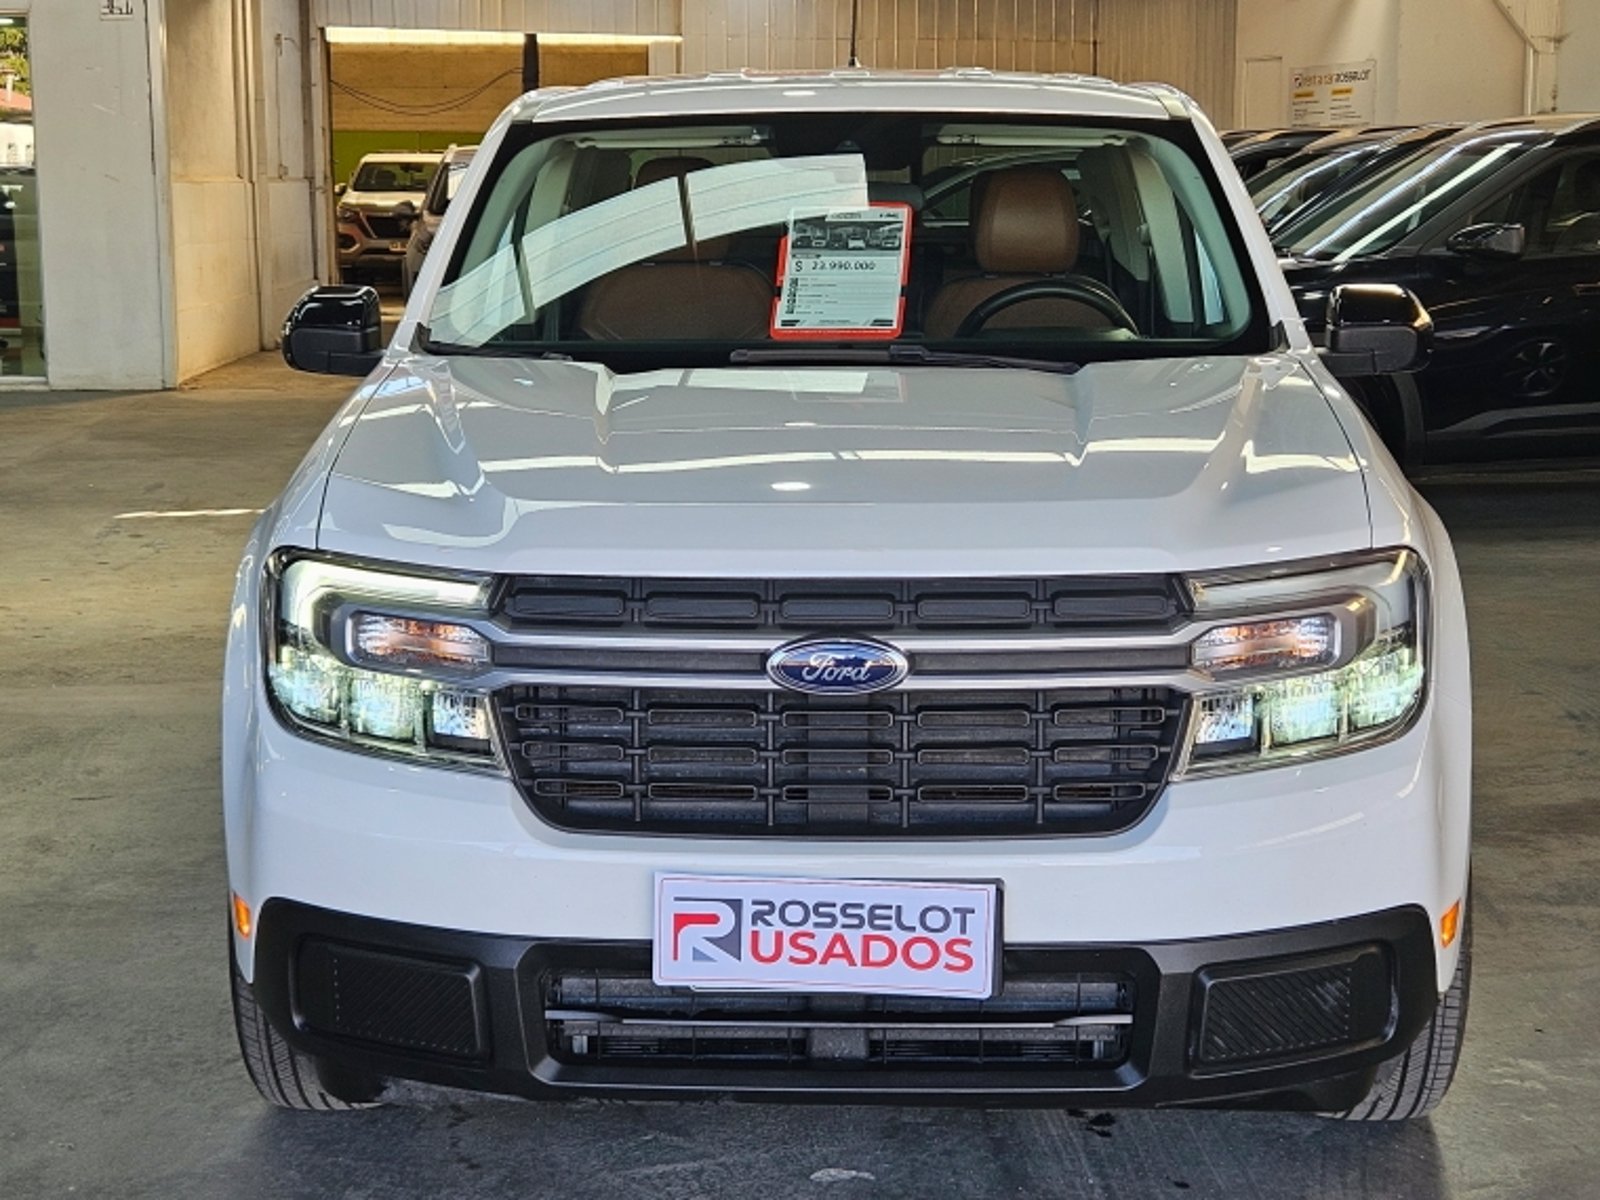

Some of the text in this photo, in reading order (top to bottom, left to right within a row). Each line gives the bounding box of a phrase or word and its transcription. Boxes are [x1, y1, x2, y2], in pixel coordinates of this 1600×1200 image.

[801, 652, 873, 682] Ford
[750, 899, 976, 935] ROSSELOT
[750, 929, 975, 973] USADOS
